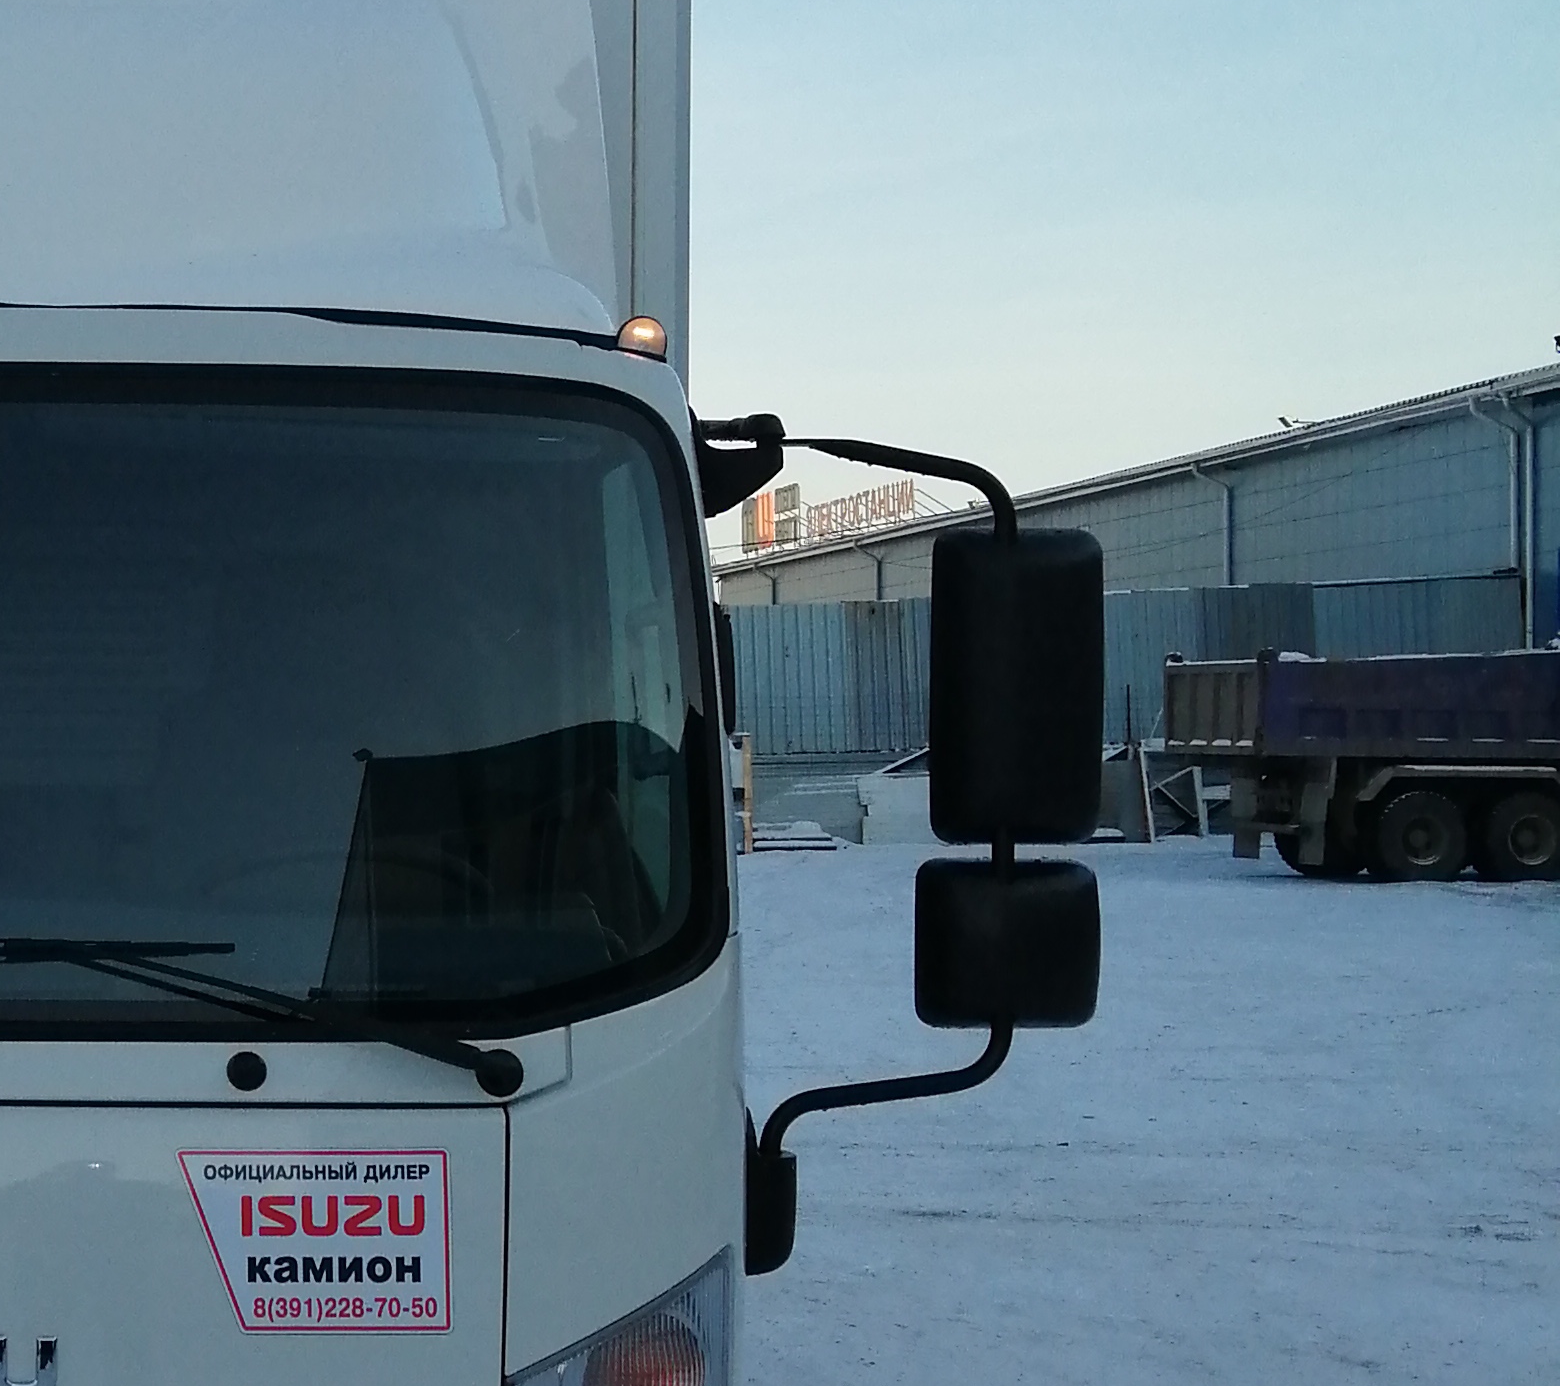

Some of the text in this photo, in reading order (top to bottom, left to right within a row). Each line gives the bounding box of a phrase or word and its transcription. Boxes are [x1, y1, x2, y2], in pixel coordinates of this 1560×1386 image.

[203, 1161, 430, 1183] ОФИЦИАЛЬНЫЙ ДИЛЕР
[241, 1195, 425, 1237] ISUZU
[247, 1256, 422, 1283] камион
[253, 1297, 438, 1323] 8(391)228-70-50
